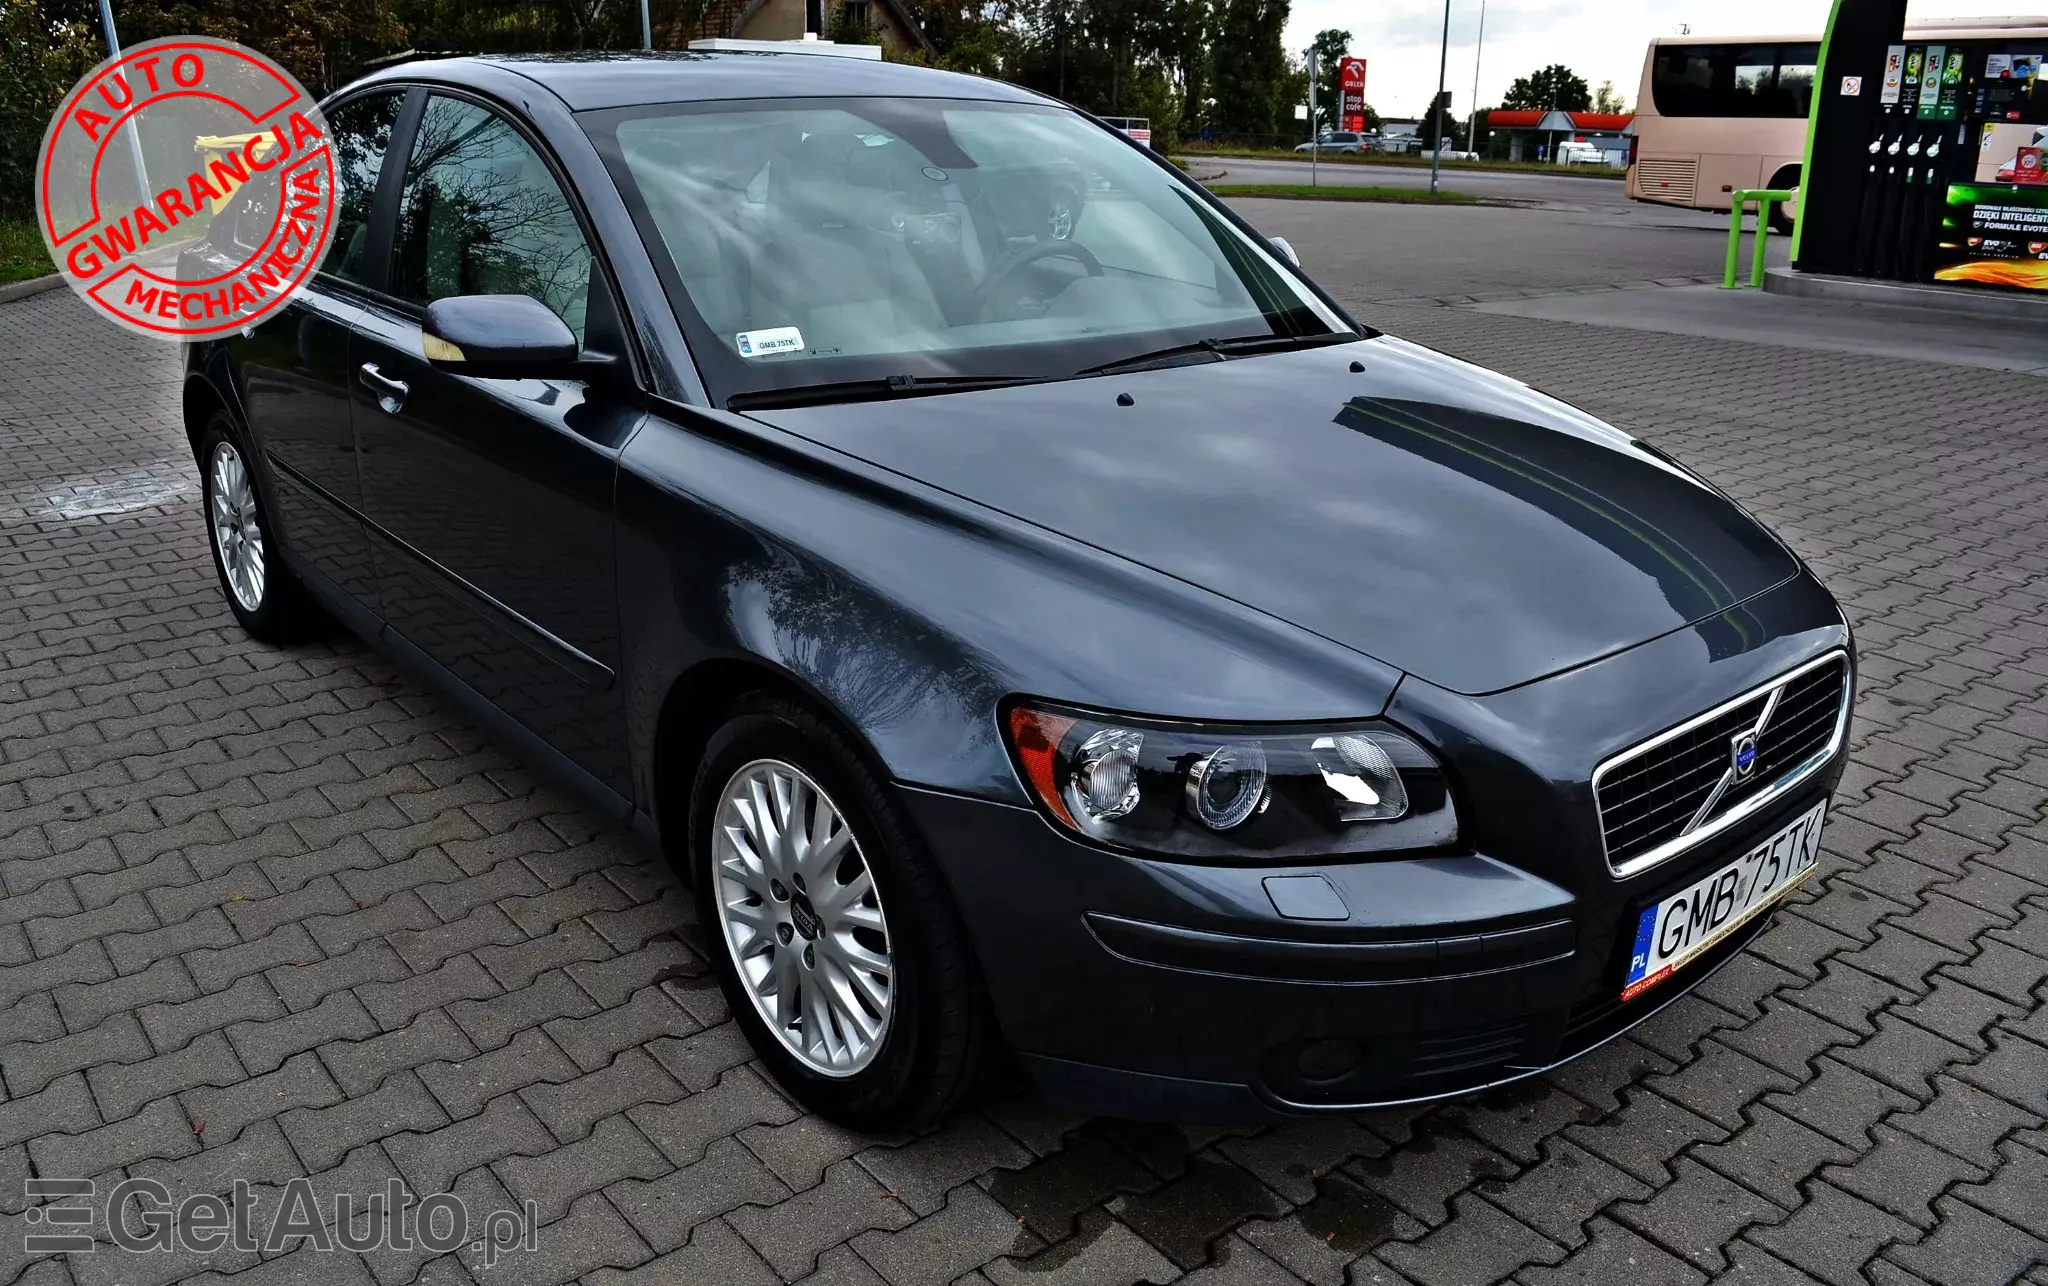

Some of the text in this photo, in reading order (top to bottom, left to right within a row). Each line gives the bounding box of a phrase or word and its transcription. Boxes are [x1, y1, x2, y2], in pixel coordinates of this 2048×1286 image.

[1346, 95, 1362, 104] stop
[1346, 103, 1362, 111] cafe
[1973, 210, 2000, 221] DZIĘKI
[1984, 221, 2048, 233] FORMULE EVOTE
[2037, 252, 2048, 260] EV
[759, 339, 796, 350] GMB 75TK
[1658, 807, 1822, 960] GMB 75TK
[1630, 952, 1646, 973] PL
[1624, 967, 1671, 999] AUTO COMPLEX
